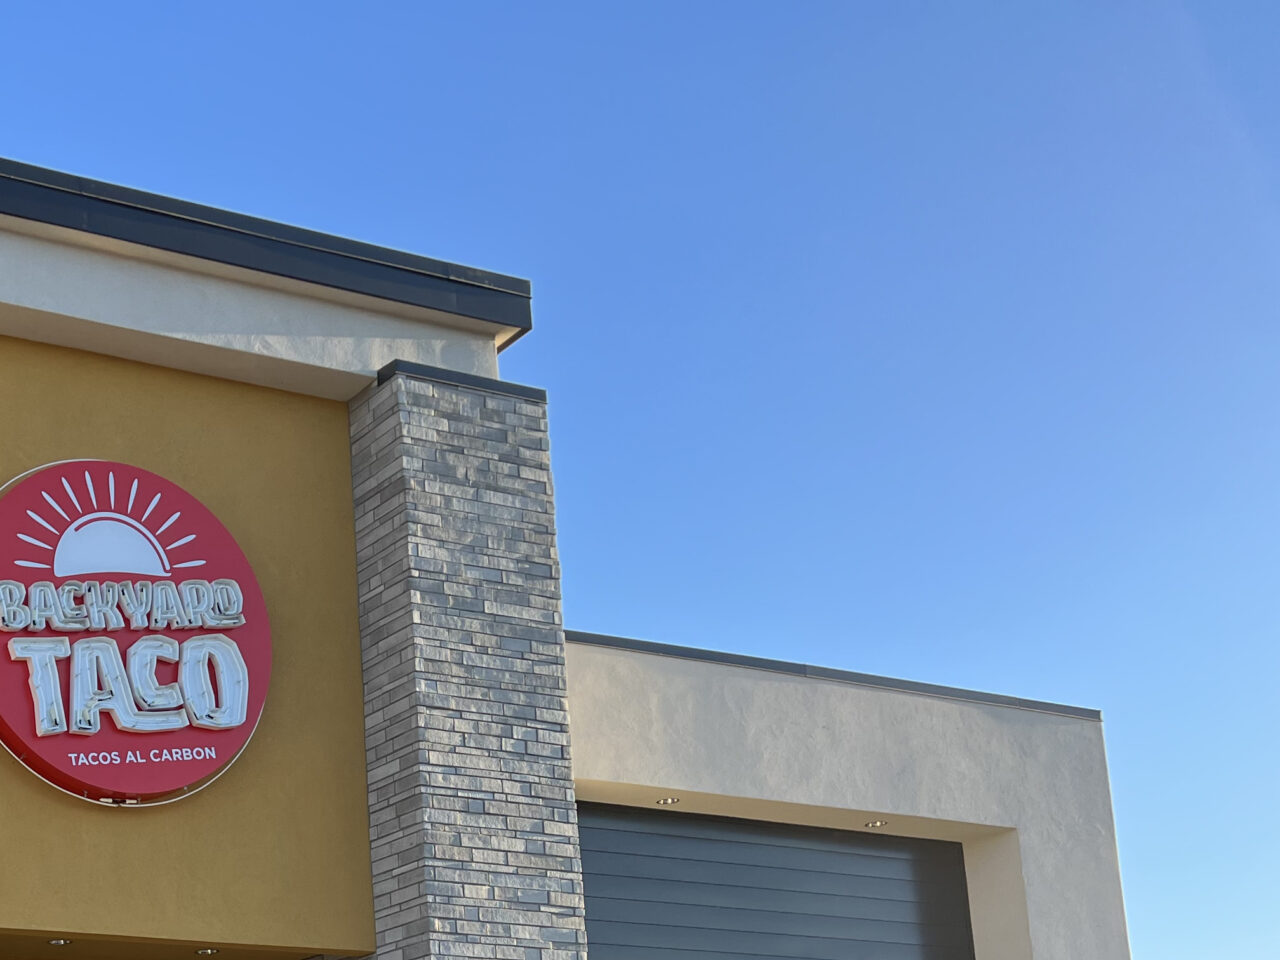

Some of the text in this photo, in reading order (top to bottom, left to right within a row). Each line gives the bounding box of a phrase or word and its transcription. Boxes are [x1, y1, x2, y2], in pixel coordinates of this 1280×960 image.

[8, 633, 249, 737] TACO
[68, 747, 217, 766] TACOS AL CARBON
